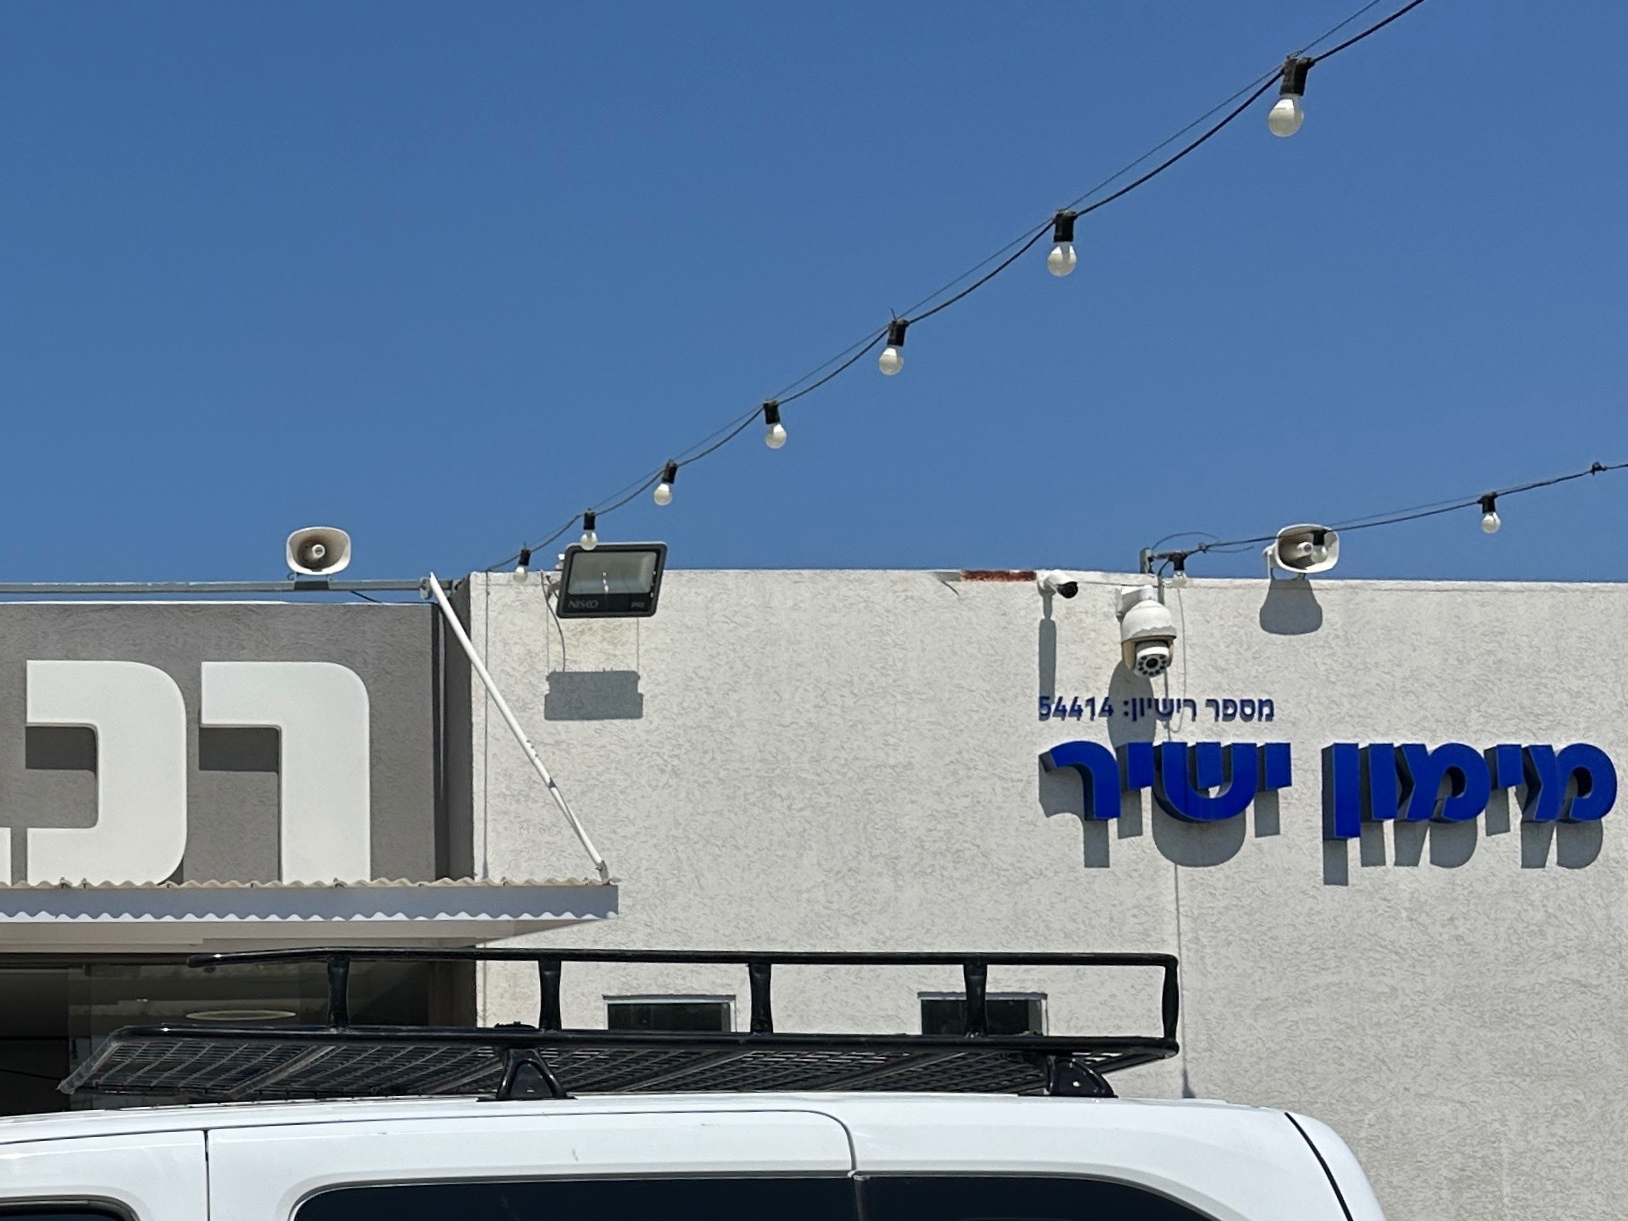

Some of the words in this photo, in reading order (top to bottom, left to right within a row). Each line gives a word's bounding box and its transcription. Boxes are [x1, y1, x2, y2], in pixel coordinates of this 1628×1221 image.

[1038, 696, 1115, 719] 54414
[1123, 697, 1198, 722] רישיון:
[1205, 697, 1275, 720] מספר
[1039, 741, 1292, 823] ישיר
[1322, 742, 1618, 839] מימון
